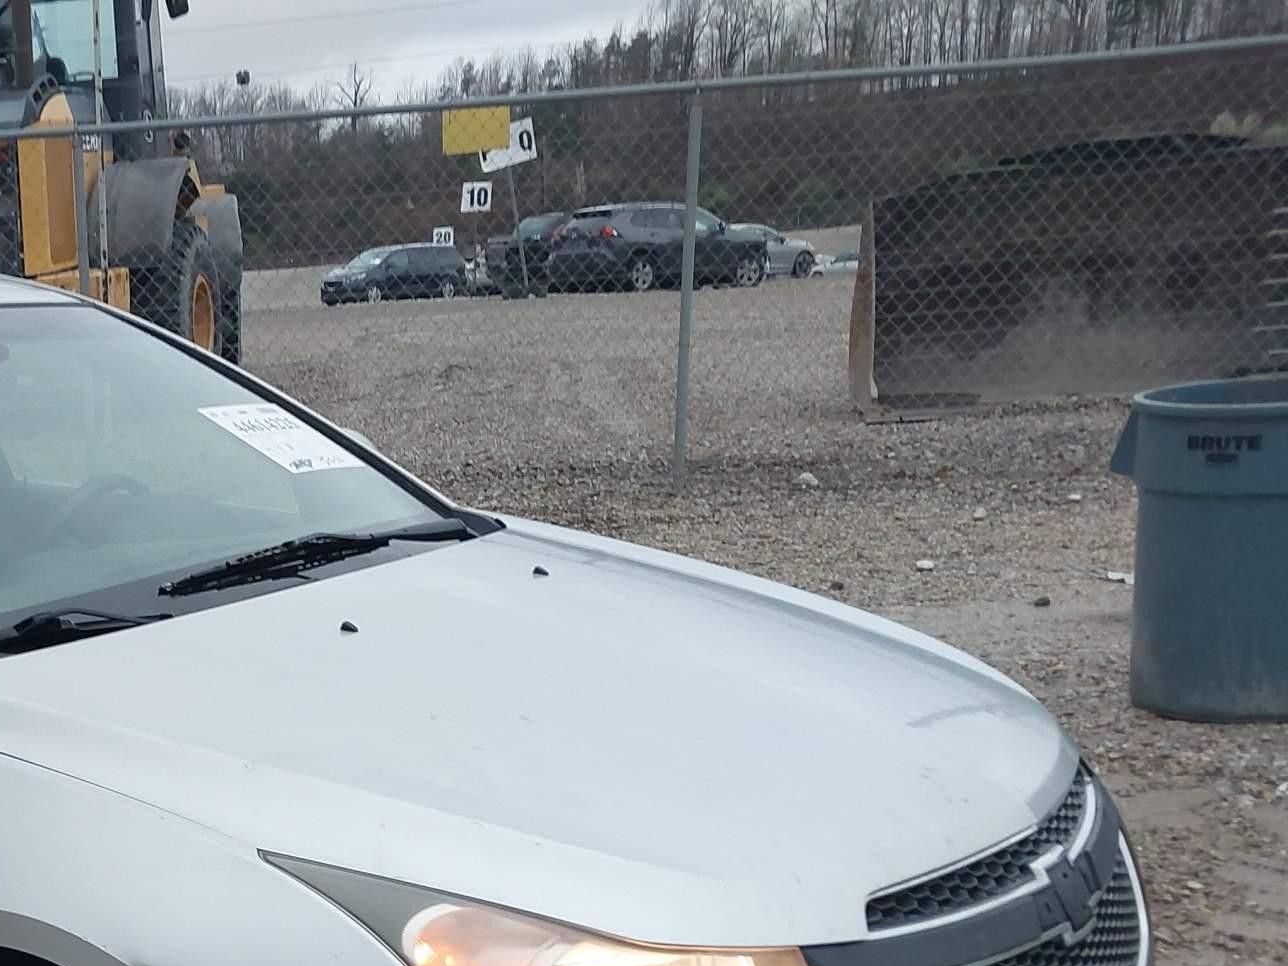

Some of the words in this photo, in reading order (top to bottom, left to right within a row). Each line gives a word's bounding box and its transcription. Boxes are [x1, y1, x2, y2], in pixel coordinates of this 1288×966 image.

[467, 187, 489, 208] 10
[435, 231, 452, 245] 20
[1187, 434, 1263, 452] BRUTE
